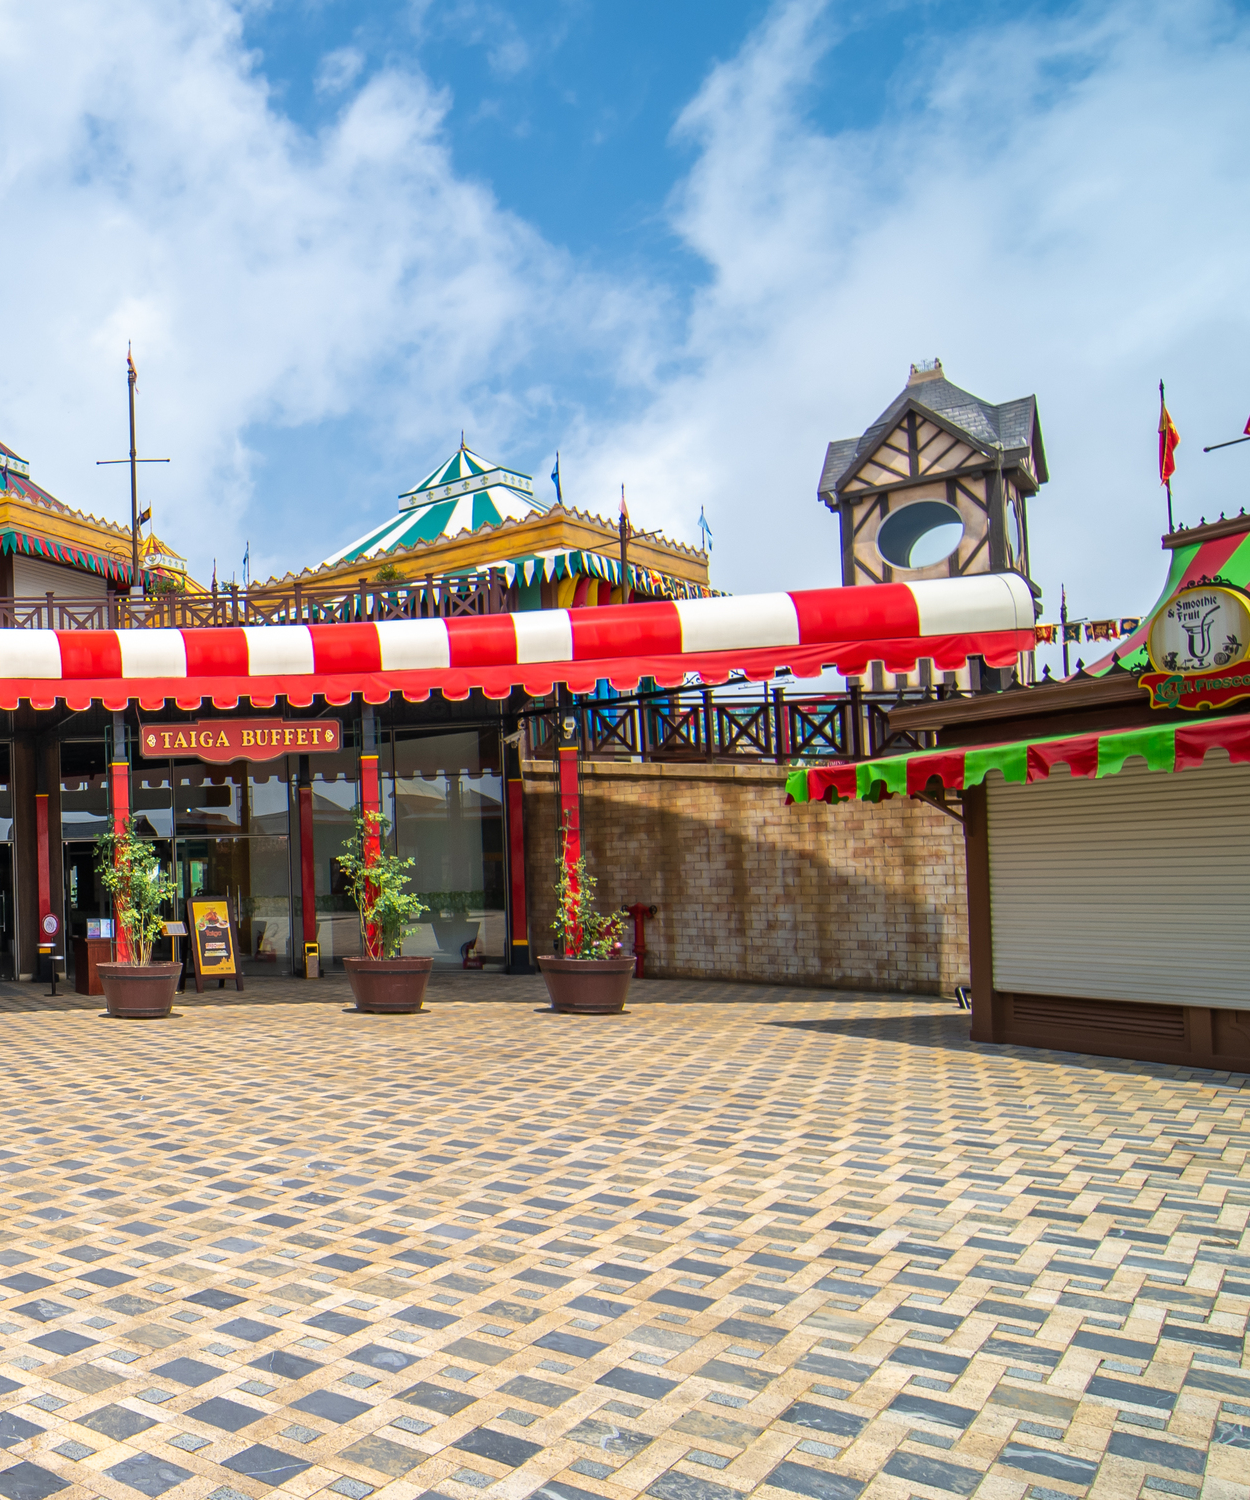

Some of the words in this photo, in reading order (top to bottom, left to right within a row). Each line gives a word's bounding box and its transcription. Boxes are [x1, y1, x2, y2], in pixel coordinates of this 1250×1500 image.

[1176, 596, 1217, 611] Smoothie
[1168, 609, 1174, 618] &
[1177, 610, 1200, 622] Fruit
[1177, 681, 1193, 694] El
[161, 730, 230, 748] TAIGA
[241, 728, 321, 746] BUFFET
